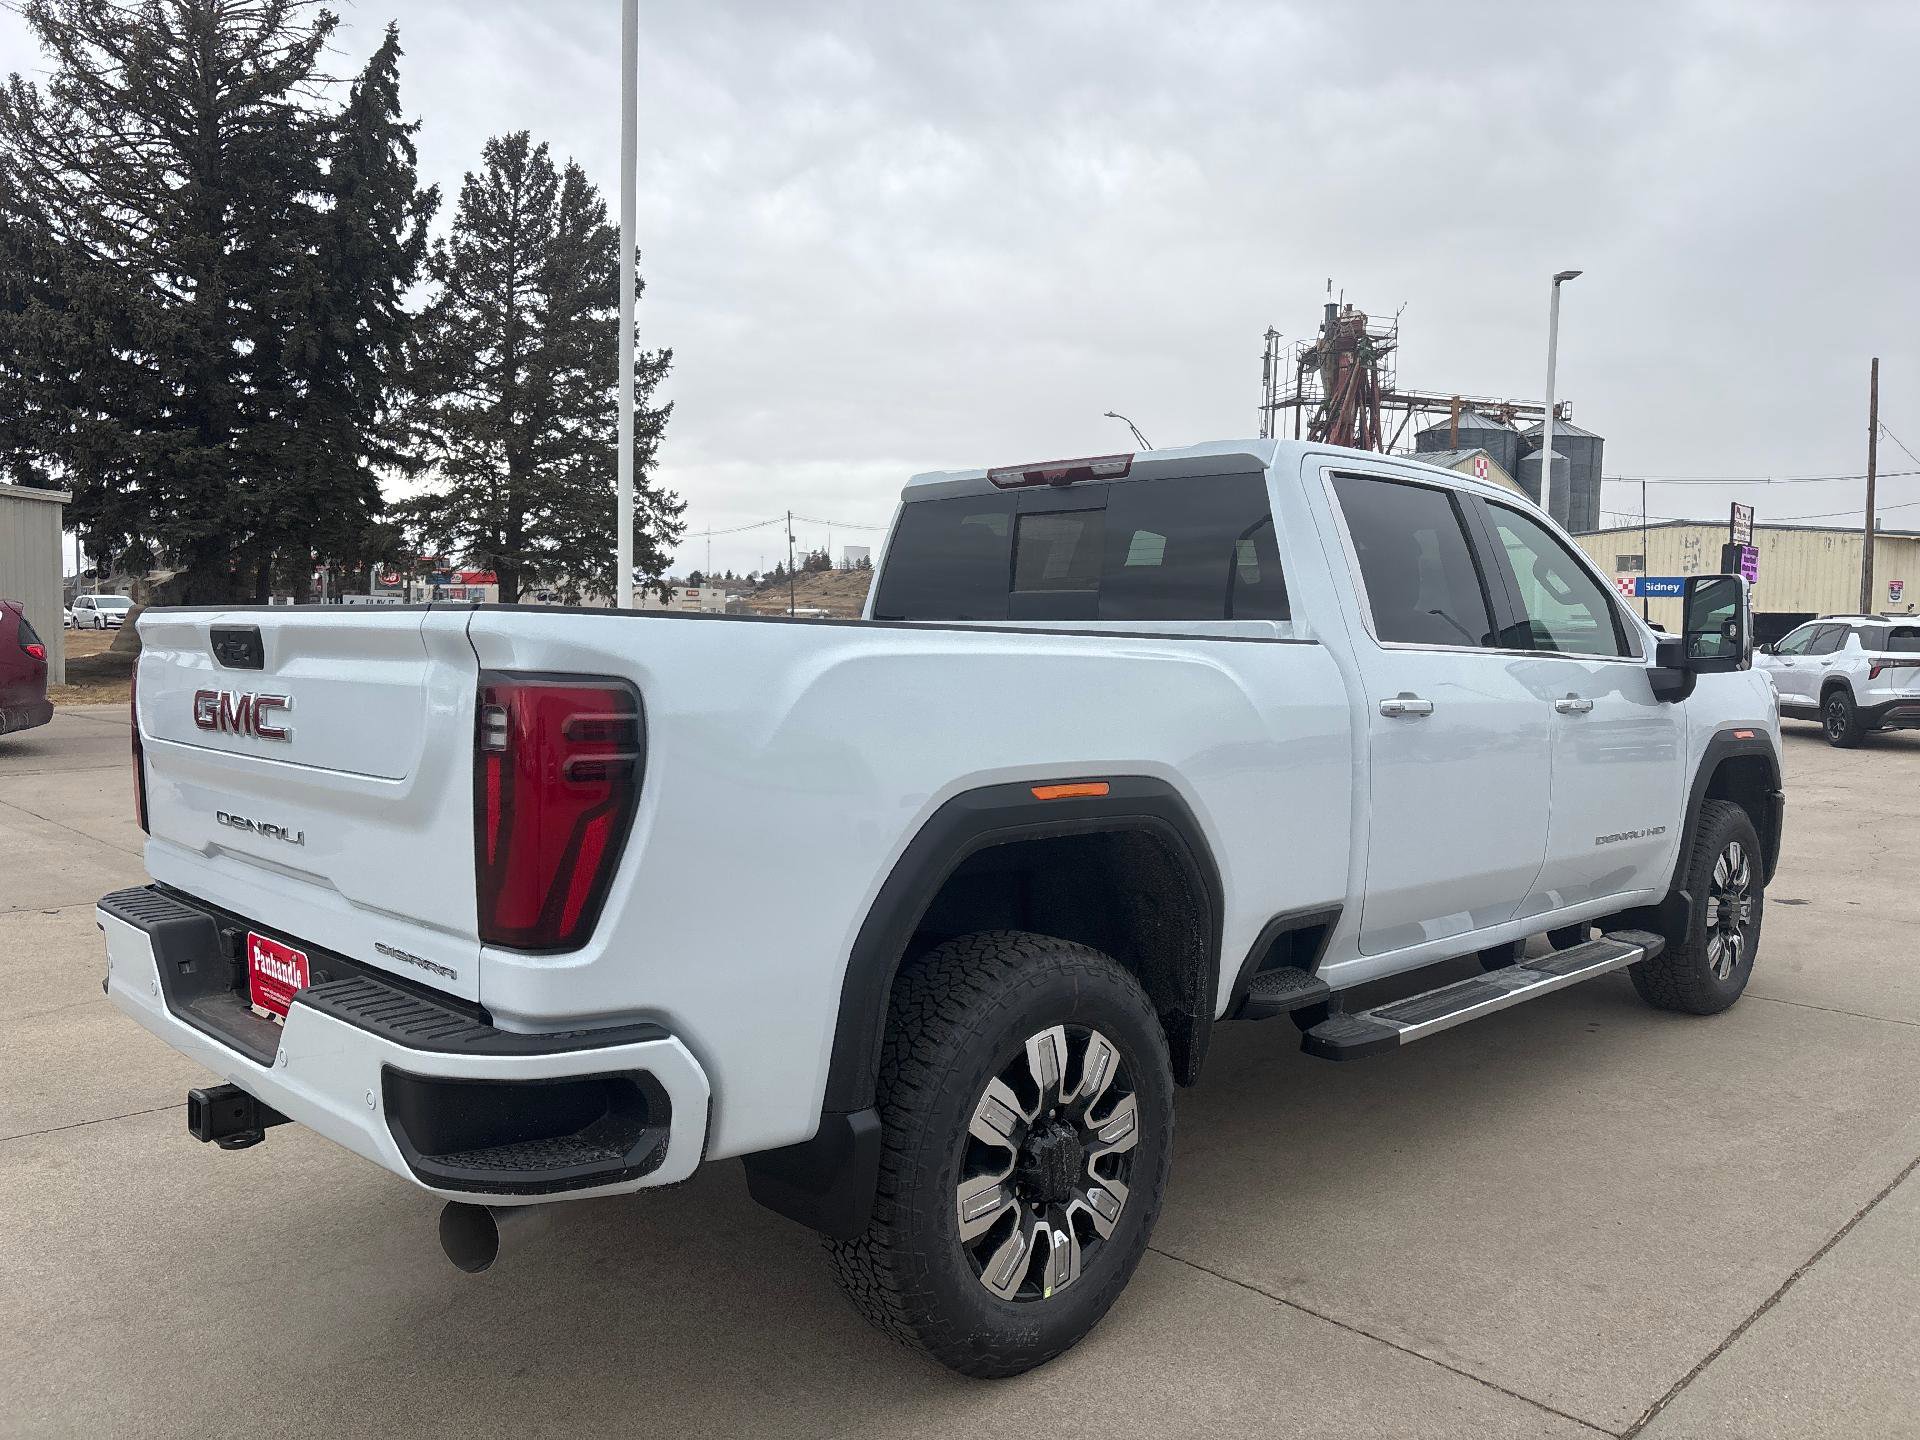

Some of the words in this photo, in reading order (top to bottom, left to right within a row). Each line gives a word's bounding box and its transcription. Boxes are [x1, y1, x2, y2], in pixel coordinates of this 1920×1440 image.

[1645, 582, 1680, 593] Sidney
[194, 689, 293, 743] GMC
[215, 810, 305, 846] DENALI
[1595, 830, 1646, 845] DENALI
[1646, 825, 1666, 837] HD
[253, 945, 302, 989] Panhandle
[374, 942, 458, 981] SIERRA
